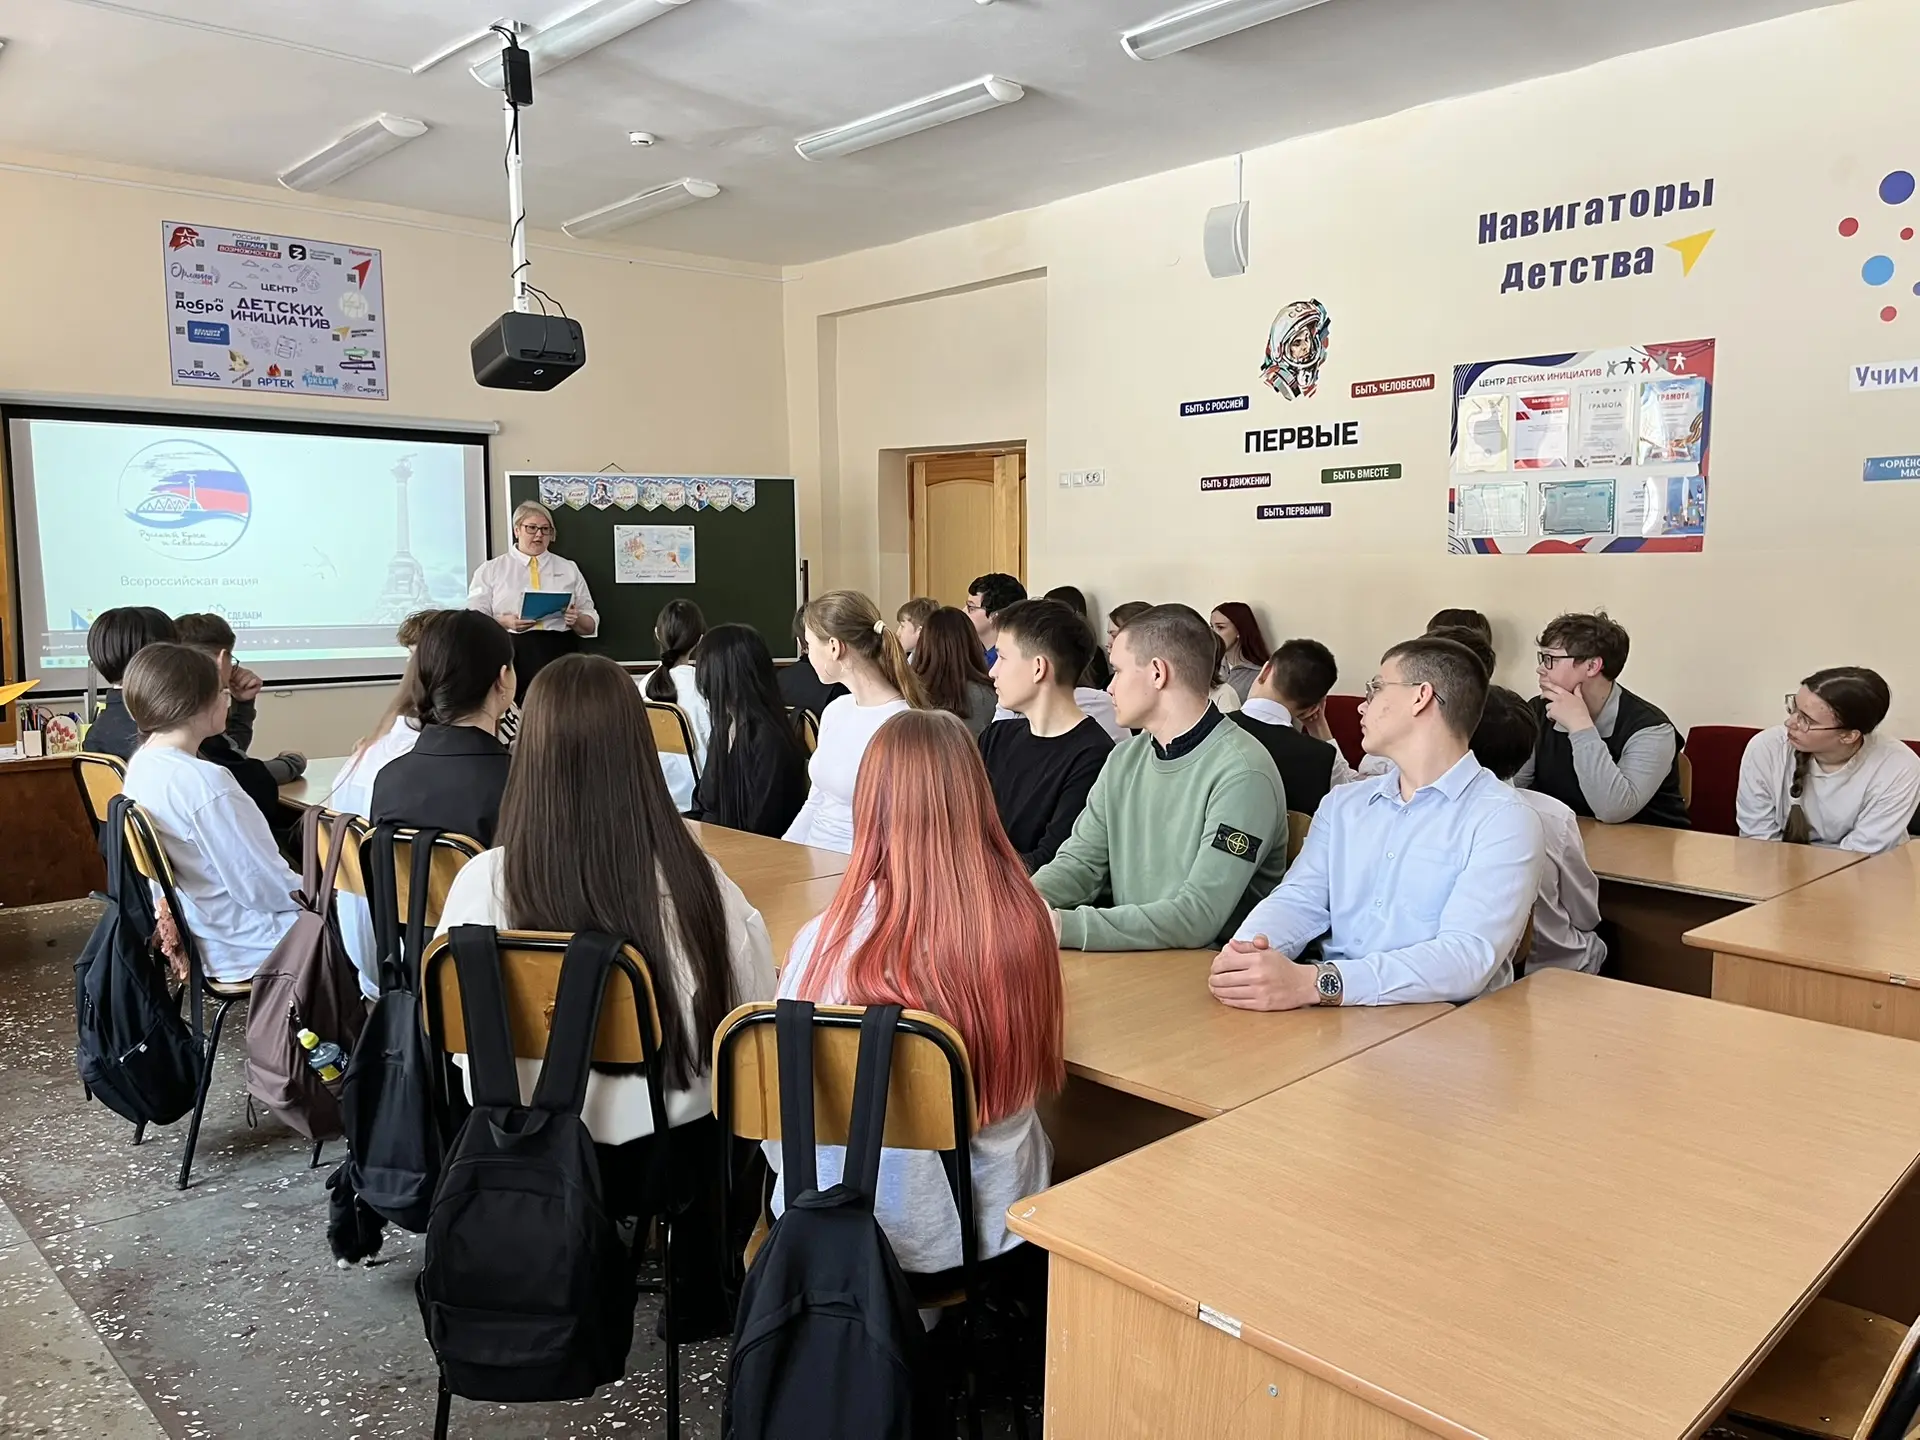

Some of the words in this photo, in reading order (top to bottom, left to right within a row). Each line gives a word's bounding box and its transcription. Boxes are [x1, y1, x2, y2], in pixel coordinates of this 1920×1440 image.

[1478, 178, 1714, 244] Навигаторы
[232, 232, 261, 241] РОССИЯ
[219, 245, 279, 258] ВОЗМОЖНОСТЕЙ
[237, 241, 265, 249] СТРАНА
[1500, 246, 1654, 294] Детства
[261, 283, 298, 294] ЦЕНТР
[236, 297, 324, 317] ДЕТСКИХ
[230, 309, 331, 330] ИНИЦИАТИВ
[257, 377, 295, 389] АРТЕК
[1479, 378, 1505, 388] ЦЕНТР
[1507, 374, 1545, 386] ДЕТСКИХ
[1546, 369, 1602, 381] ИНИЦИАТИВ
[1856, 366, 1918, 387] Учим
[1355, 383, 1378, 396] БЫТЬ
[1379, 377, 1431, 392] ЧЕЛОВЕКОМ
[1185, 403, 1204, 414] БЫТЬ
[1205, 402, 1211, 412] С
[1212, 398, 1244, 411] РОССИЕЙ
[1245, 421, 1358, 453] ПЕРВЫЕ
[1333, 470, 1355, 480] БЫТЬ
[1357, 467, 1389, 479] ВМЕСТЕ
[1202, 479, 1221, 489] БЫТЬ
[1223, 478, 1228, 488] В
[1229, 476, 1270, 488] ДВИЖЕНИИ
[1264, 507, 1284, 517] БЫТЬ
[1286, 504, 1324, 516] ПЕРВЫМИ
[121, 576, 218, 587] Всероссийская
[222, 577, 259, 588] акция
